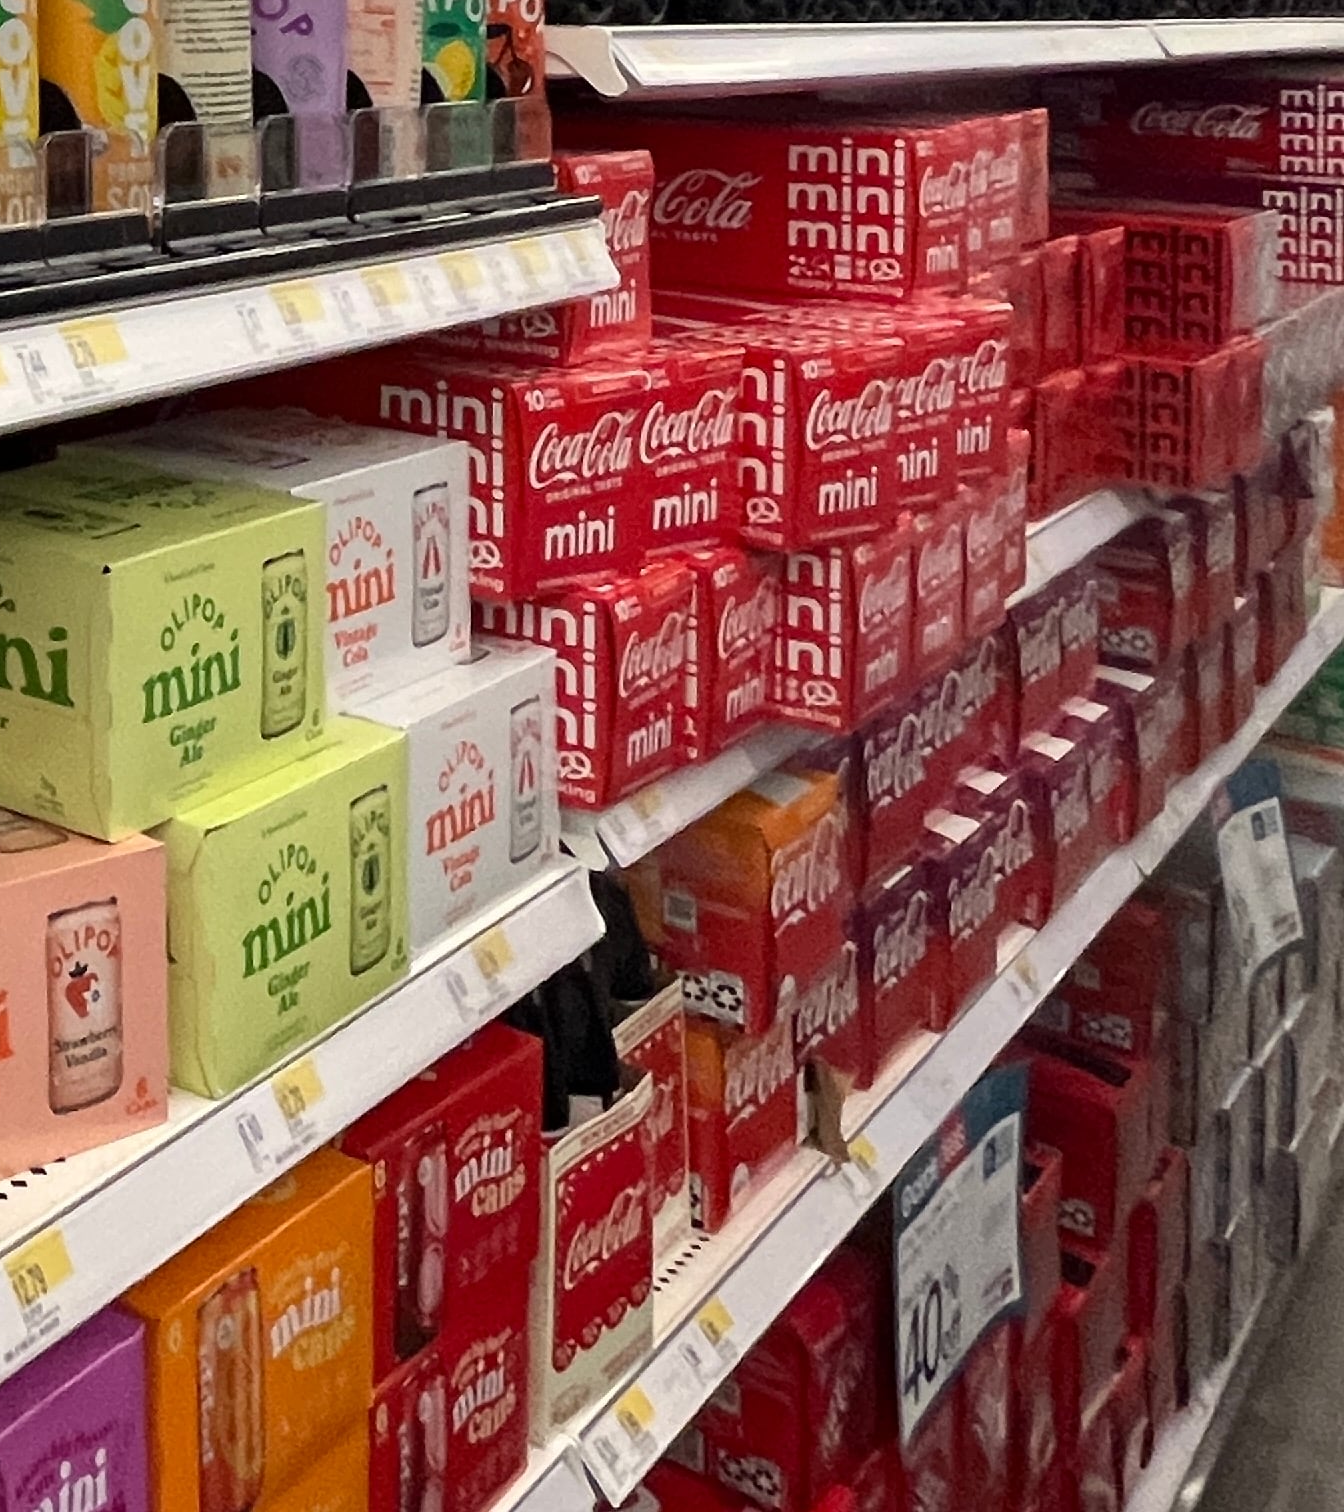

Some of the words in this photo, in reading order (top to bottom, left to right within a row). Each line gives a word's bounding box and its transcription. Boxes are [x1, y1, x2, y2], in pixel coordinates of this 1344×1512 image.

[788, 138, 906, 176] mini
[788, 178, 906, 216] mini
[788, 216, 906, 256] mini
[590, 279, 637, 329] mini
[379, 380, 505, 438] mini
[524, 390, 546, 412] 10
[528, 408, 640, 490] Coca-Cola
[652, 477, 718, 532] mini
[817, 465, 879, 517] mini
[544, 505, 616, 562] mini
[159, 591, 226, 653] OLIPOP
[140, 627, 242, 725] mini
[168, 716, 217, 749] Ginger
[179, 740, 204, 769] Ale
[626, 702, 674, 768] mini
[424, 775, 496, 857] mini
[242, 872, 332, 979] mini
[454, 1128, 513, 1204] mini
[271, 1266, 341, 1360] mini
[291, 1311, 356, 1371] cans
[452, 1348, 506, 1434] mini
